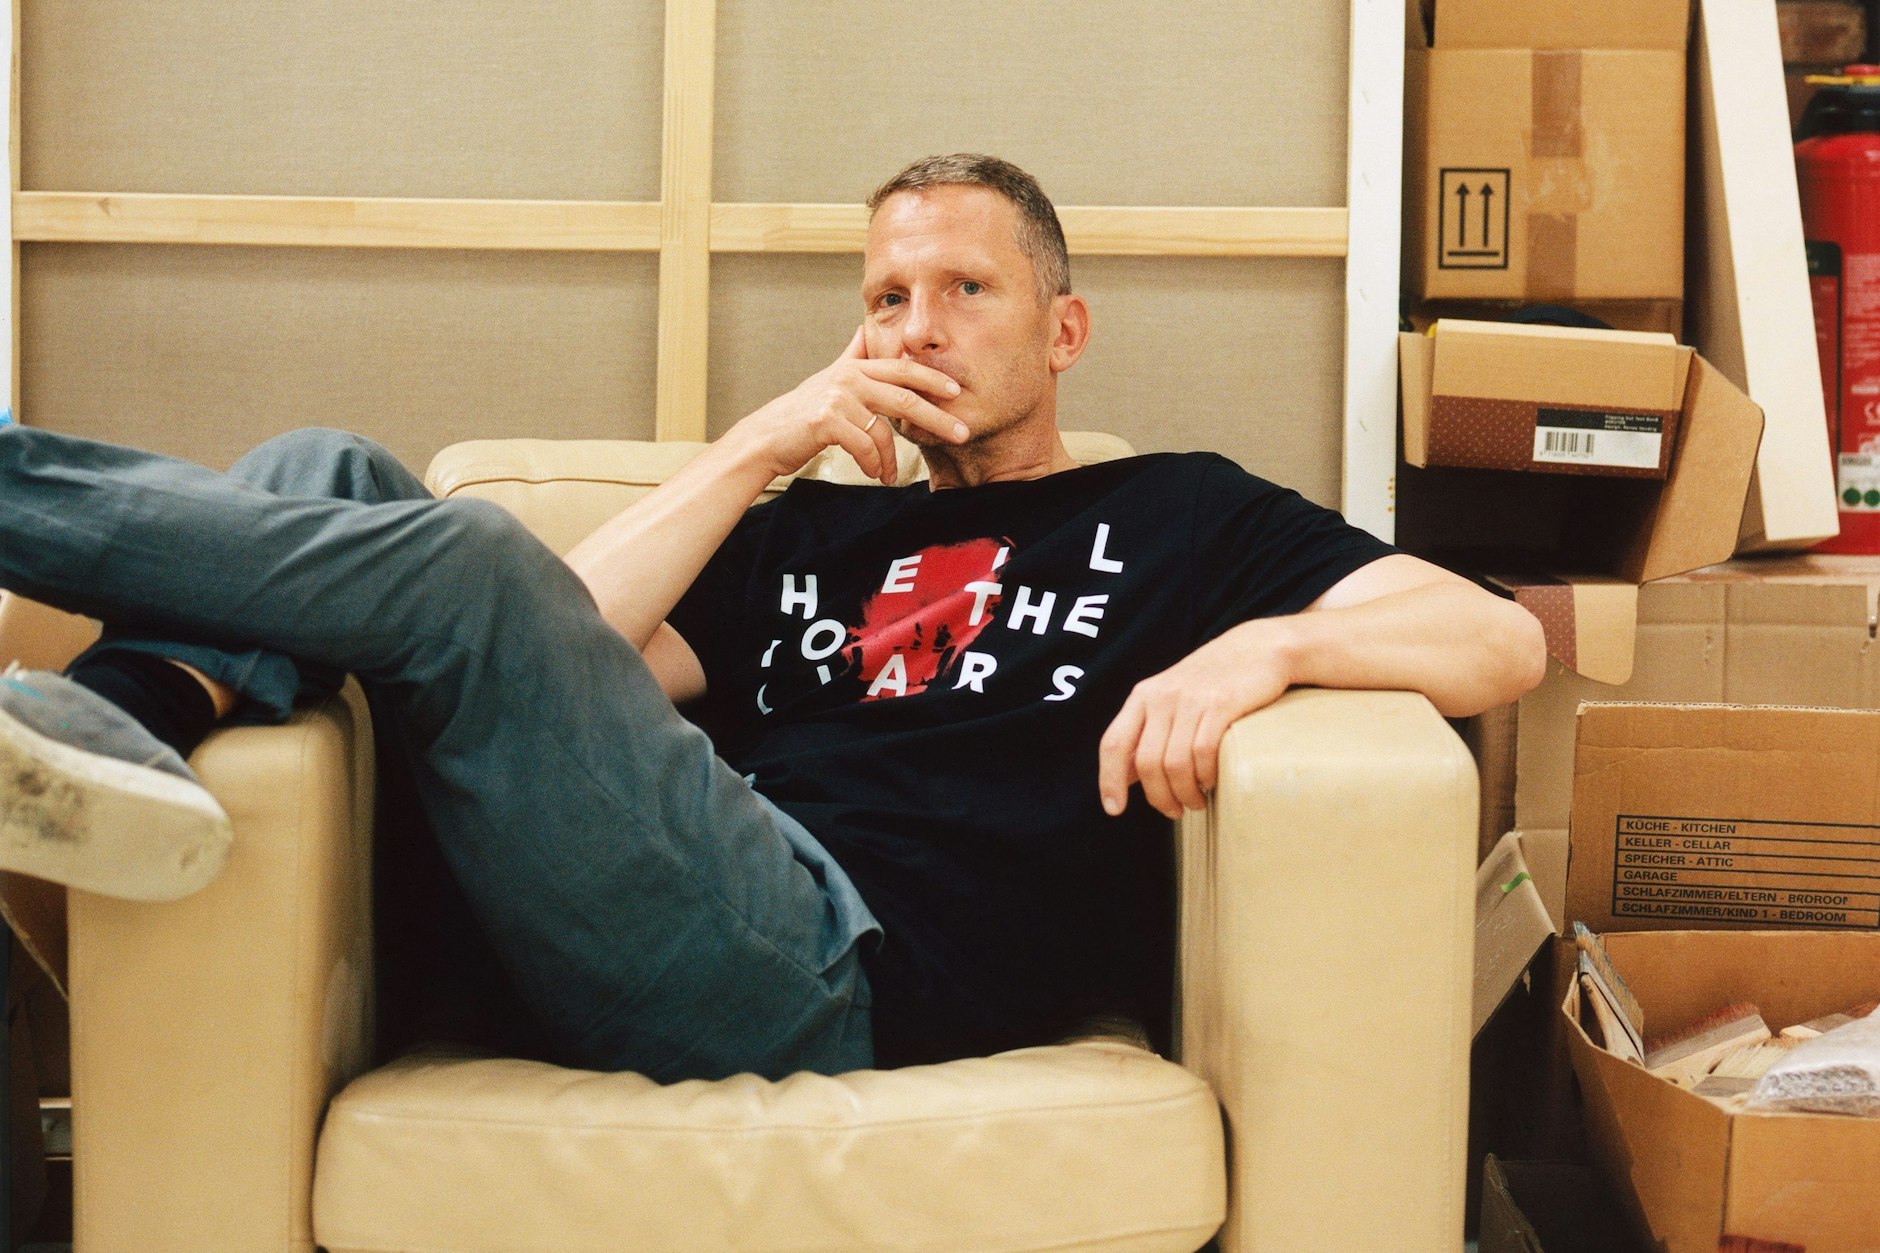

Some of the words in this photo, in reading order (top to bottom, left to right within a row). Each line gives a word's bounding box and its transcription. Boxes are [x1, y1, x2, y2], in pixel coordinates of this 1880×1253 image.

[963, 581, 1110, 638] THE
[1626, 820, 1670, 832] KÜCHE
[1681, 823, 1736, 834] KITCHEN
[1625, 837, 1671, 848] KELLER
[1683, 840, 1731, 850] CELLAR
[1624, 854, 1686, 865] SPEICHER
[1696, 857, 1734, 867] ATTIC
[1624, 870, 1678, 881] GARAGE
[1623, 886, 1777, 902] SCHLAFZIMMER/ELTERN
[1622, 902, 1758, 918] SCHLAFZIMMER/KIND
[1762, 909, 1768, 918] 1
[1780, 910, 1847, 922] BEDROOM
